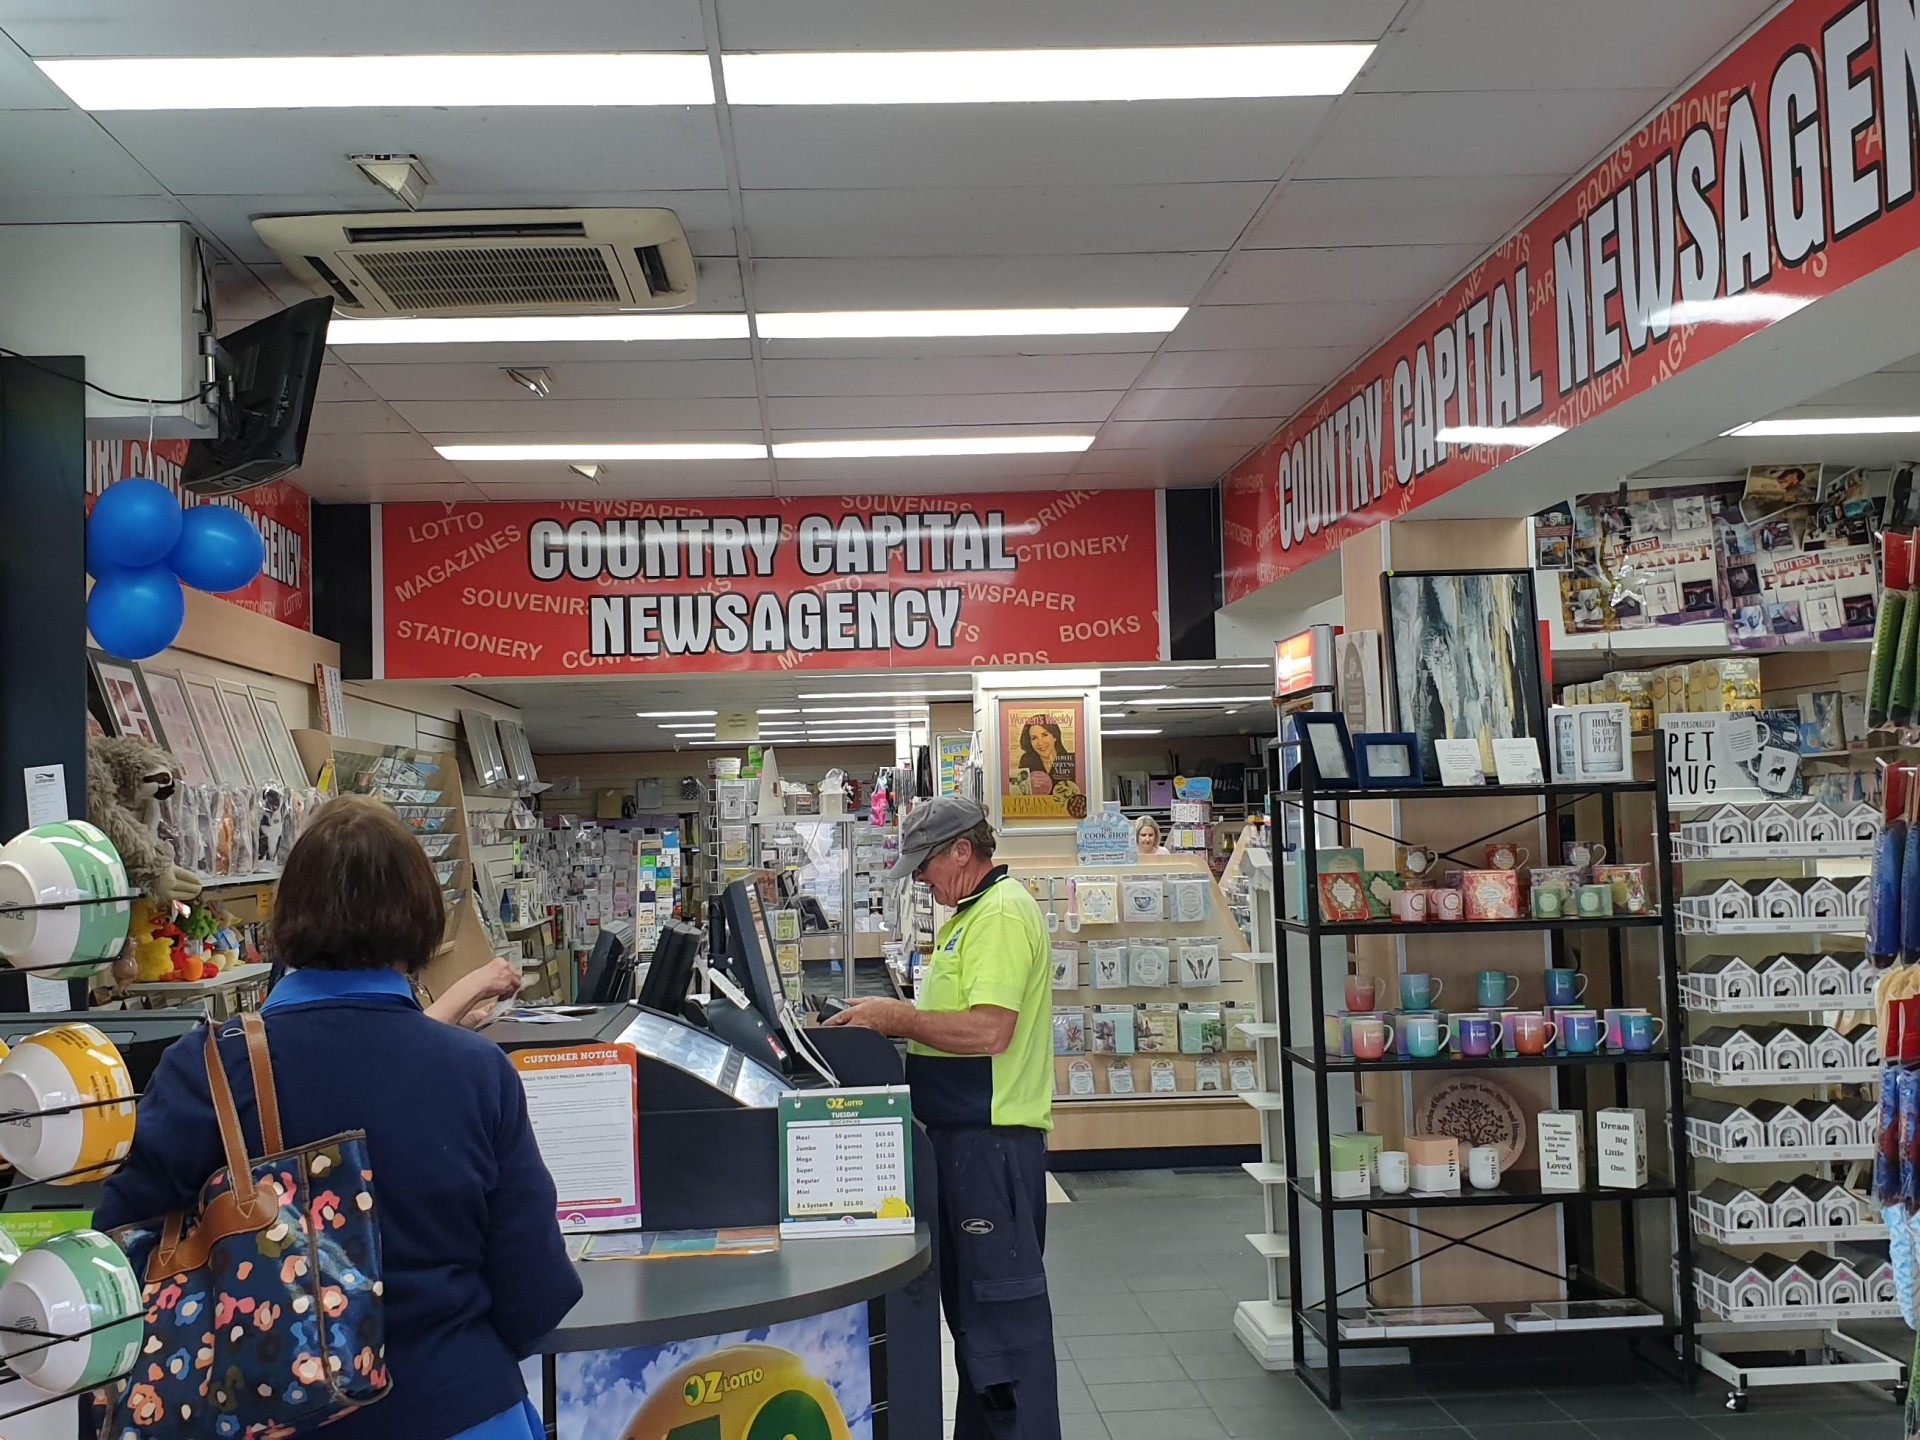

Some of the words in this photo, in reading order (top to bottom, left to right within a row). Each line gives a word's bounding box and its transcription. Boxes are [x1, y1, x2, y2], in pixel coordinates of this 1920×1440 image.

[1577, 141, 1633, 219] BOOKS
[1278, 376, 1384, 551] COUNTRY
[1391, 263, 1543, 485] CAPITAL
[409, 511, 484, 543] LOTTO
[529, 516, 780, 580] COUNTRY
[798, 510, 1017, 575] CAPITAL
[1604, 544, 1712, 571] PANET
[394, 525, 522, 602] MAGAZINES
[1761, 558, 1872, 590] PLANET
[1775, 556, 1818, 573] HOTTEST
[462, 588, 589, 616] SOUVENIR
[589, 588, 962, 656] NEWSAGENCY
[1059, 615, 1141, 643] BOOKS
[397, 620, 543, 661] STATIONERY
[970, 650, 1049, 666] CARDS
[1009, 712, 1045, 726] Women's
[1045, 712, 1074, 726] Weekly
[1668, 731, 1715, 763] PET
[1668, 764, 1717, 795] MUG
[1084, 832, 1106, 840] COOK
[523, 1052, 578, 1064] CUSTOMER
[580, 1050, 618, 1060] NOTICE
[826, 1097, 845, 1109] OZ
[844, 1099, 864, 1107] LOTTO
[1600, 1121, 1629, 1131] Dream
[1604, 1149, 1624, 1157] Little
[1614, 1136, 1627, 1145] Big
[1546, 1161, 1572, 1170] Loved
[683, 1370, 723, 1407] OZ
[723, 1367, 765, 1392] LOTTO
